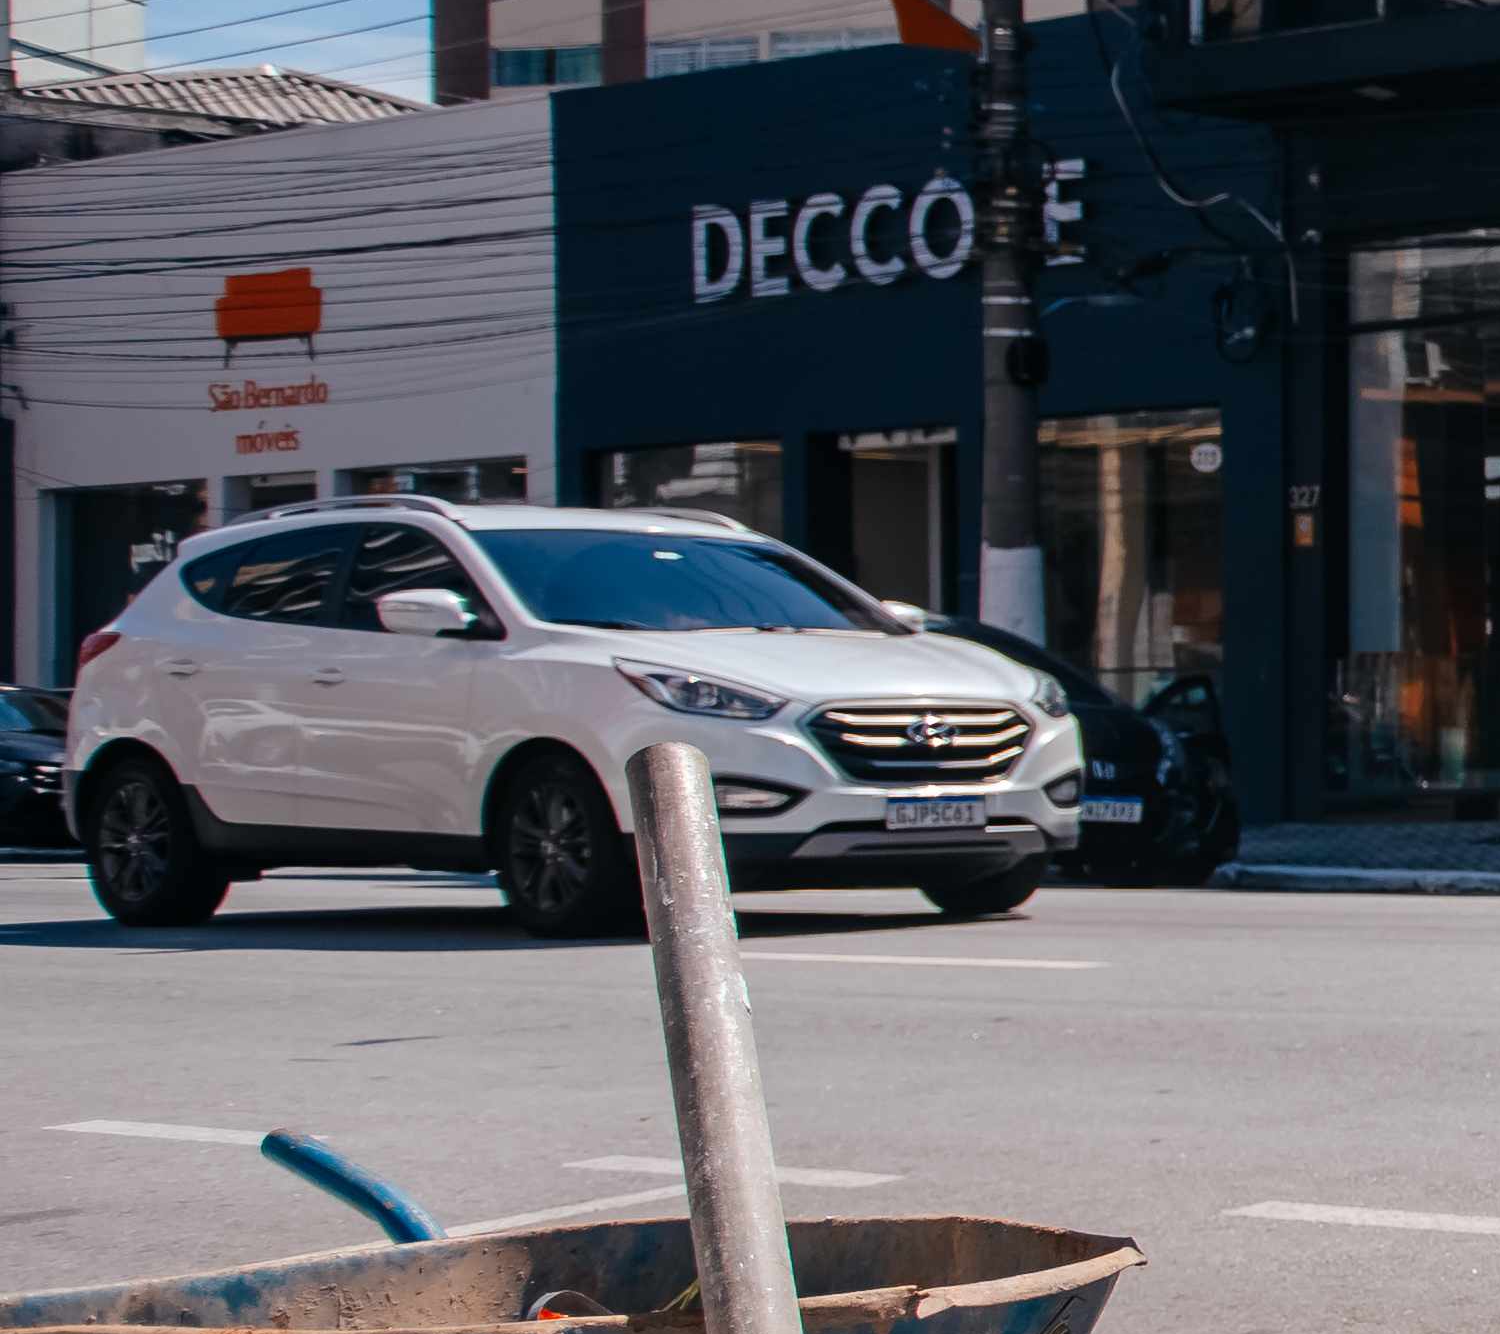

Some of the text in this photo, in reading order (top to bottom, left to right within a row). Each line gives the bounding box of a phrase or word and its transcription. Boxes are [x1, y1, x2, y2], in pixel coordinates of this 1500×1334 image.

[692, 157, 1087, 305] DECCOE
[243, 373, 328, 409] Bernardo
[235, 419, 301, 455] móveis
[1288, 485, 1320, 509] 327
[895, 800, 976, 824] GJP5C61
